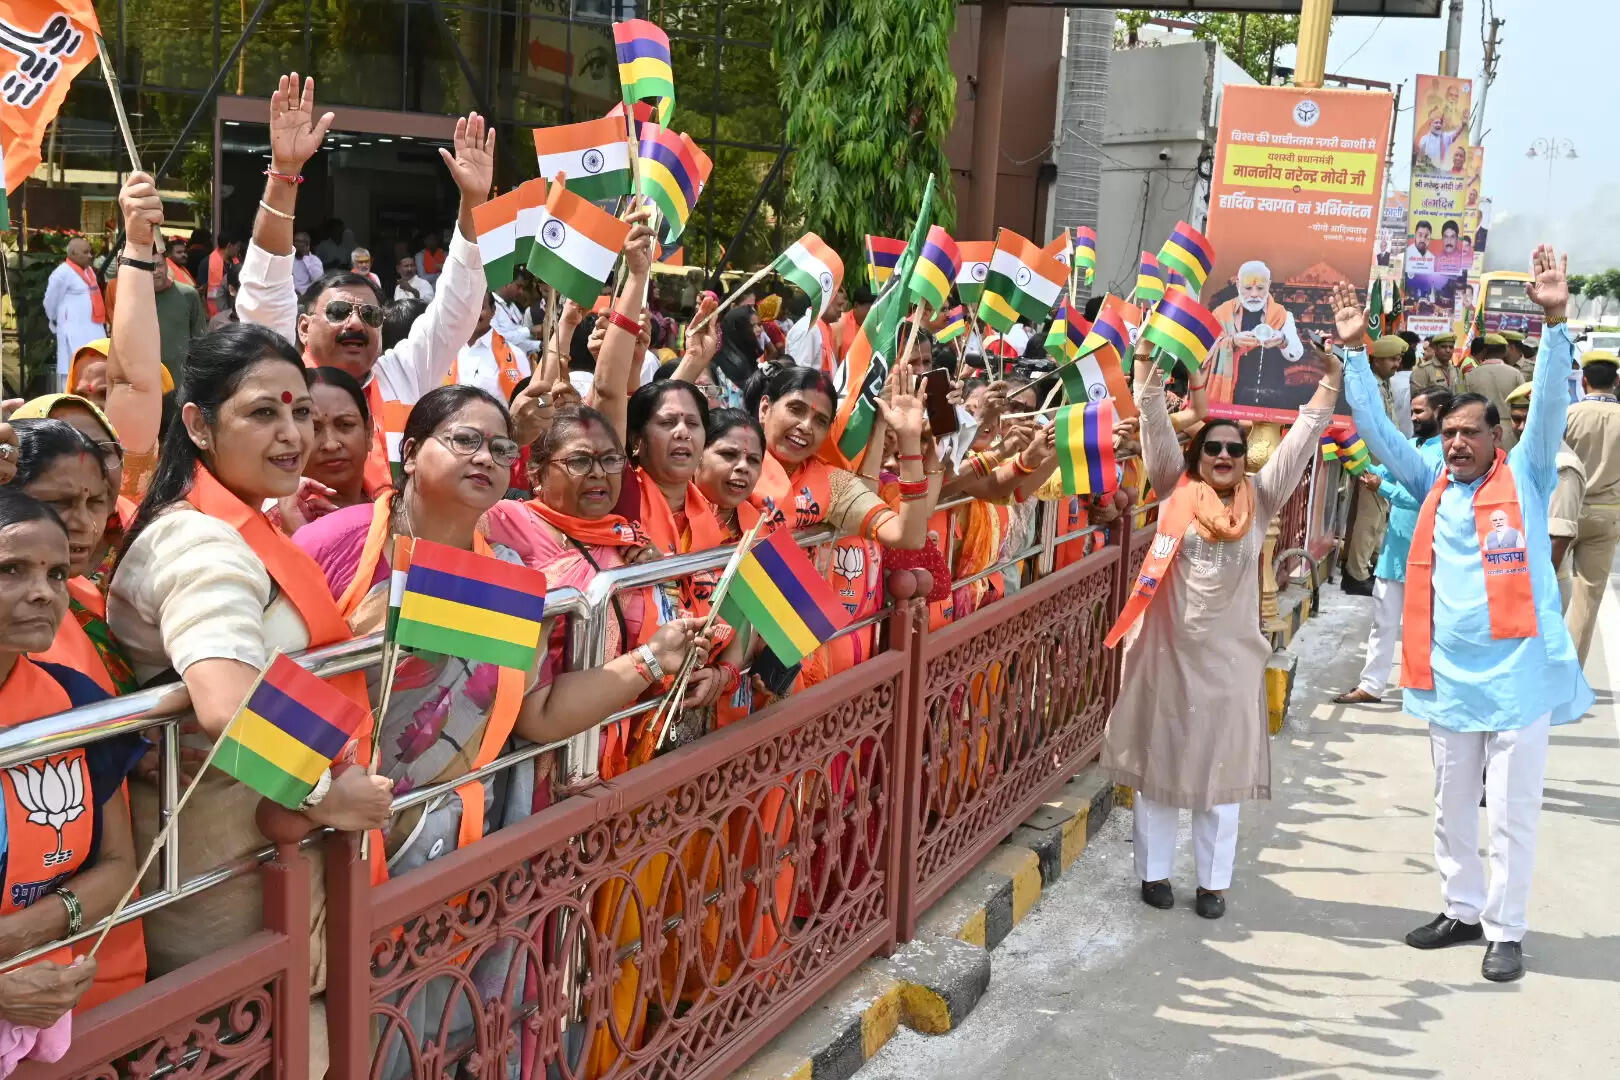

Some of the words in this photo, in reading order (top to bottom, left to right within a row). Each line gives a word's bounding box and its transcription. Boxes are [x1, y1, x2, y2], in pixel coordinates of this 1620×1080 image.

[1231, 129, 1255, 142] विश्व
[1256, 131, 1269, 144] की
[1316, 136, 1339, 148] नगरी
[1340, 138, 1366, 150] काशी
[1267, 152, 1295, 163] यशस्वी
[1297, 153, 1334, 166] प्रधानमंत्री
[1233, 164, 1282, 180] माननीय
[1285, 166, 1318, 184] नरेन्द्र
[1320, 168, 1348, 185] मोदी
[1350, 170, 1366, 186] जी
[1219, 191, 1256, 209] हार्दिक
[1257, 196, 1296, 213] स्वागत
[1297, 201, 1312, 214] एवं
[1314, 198, 1373, 219] अभिनंदन
[1485, 551, 1525, 564] भाजपा
